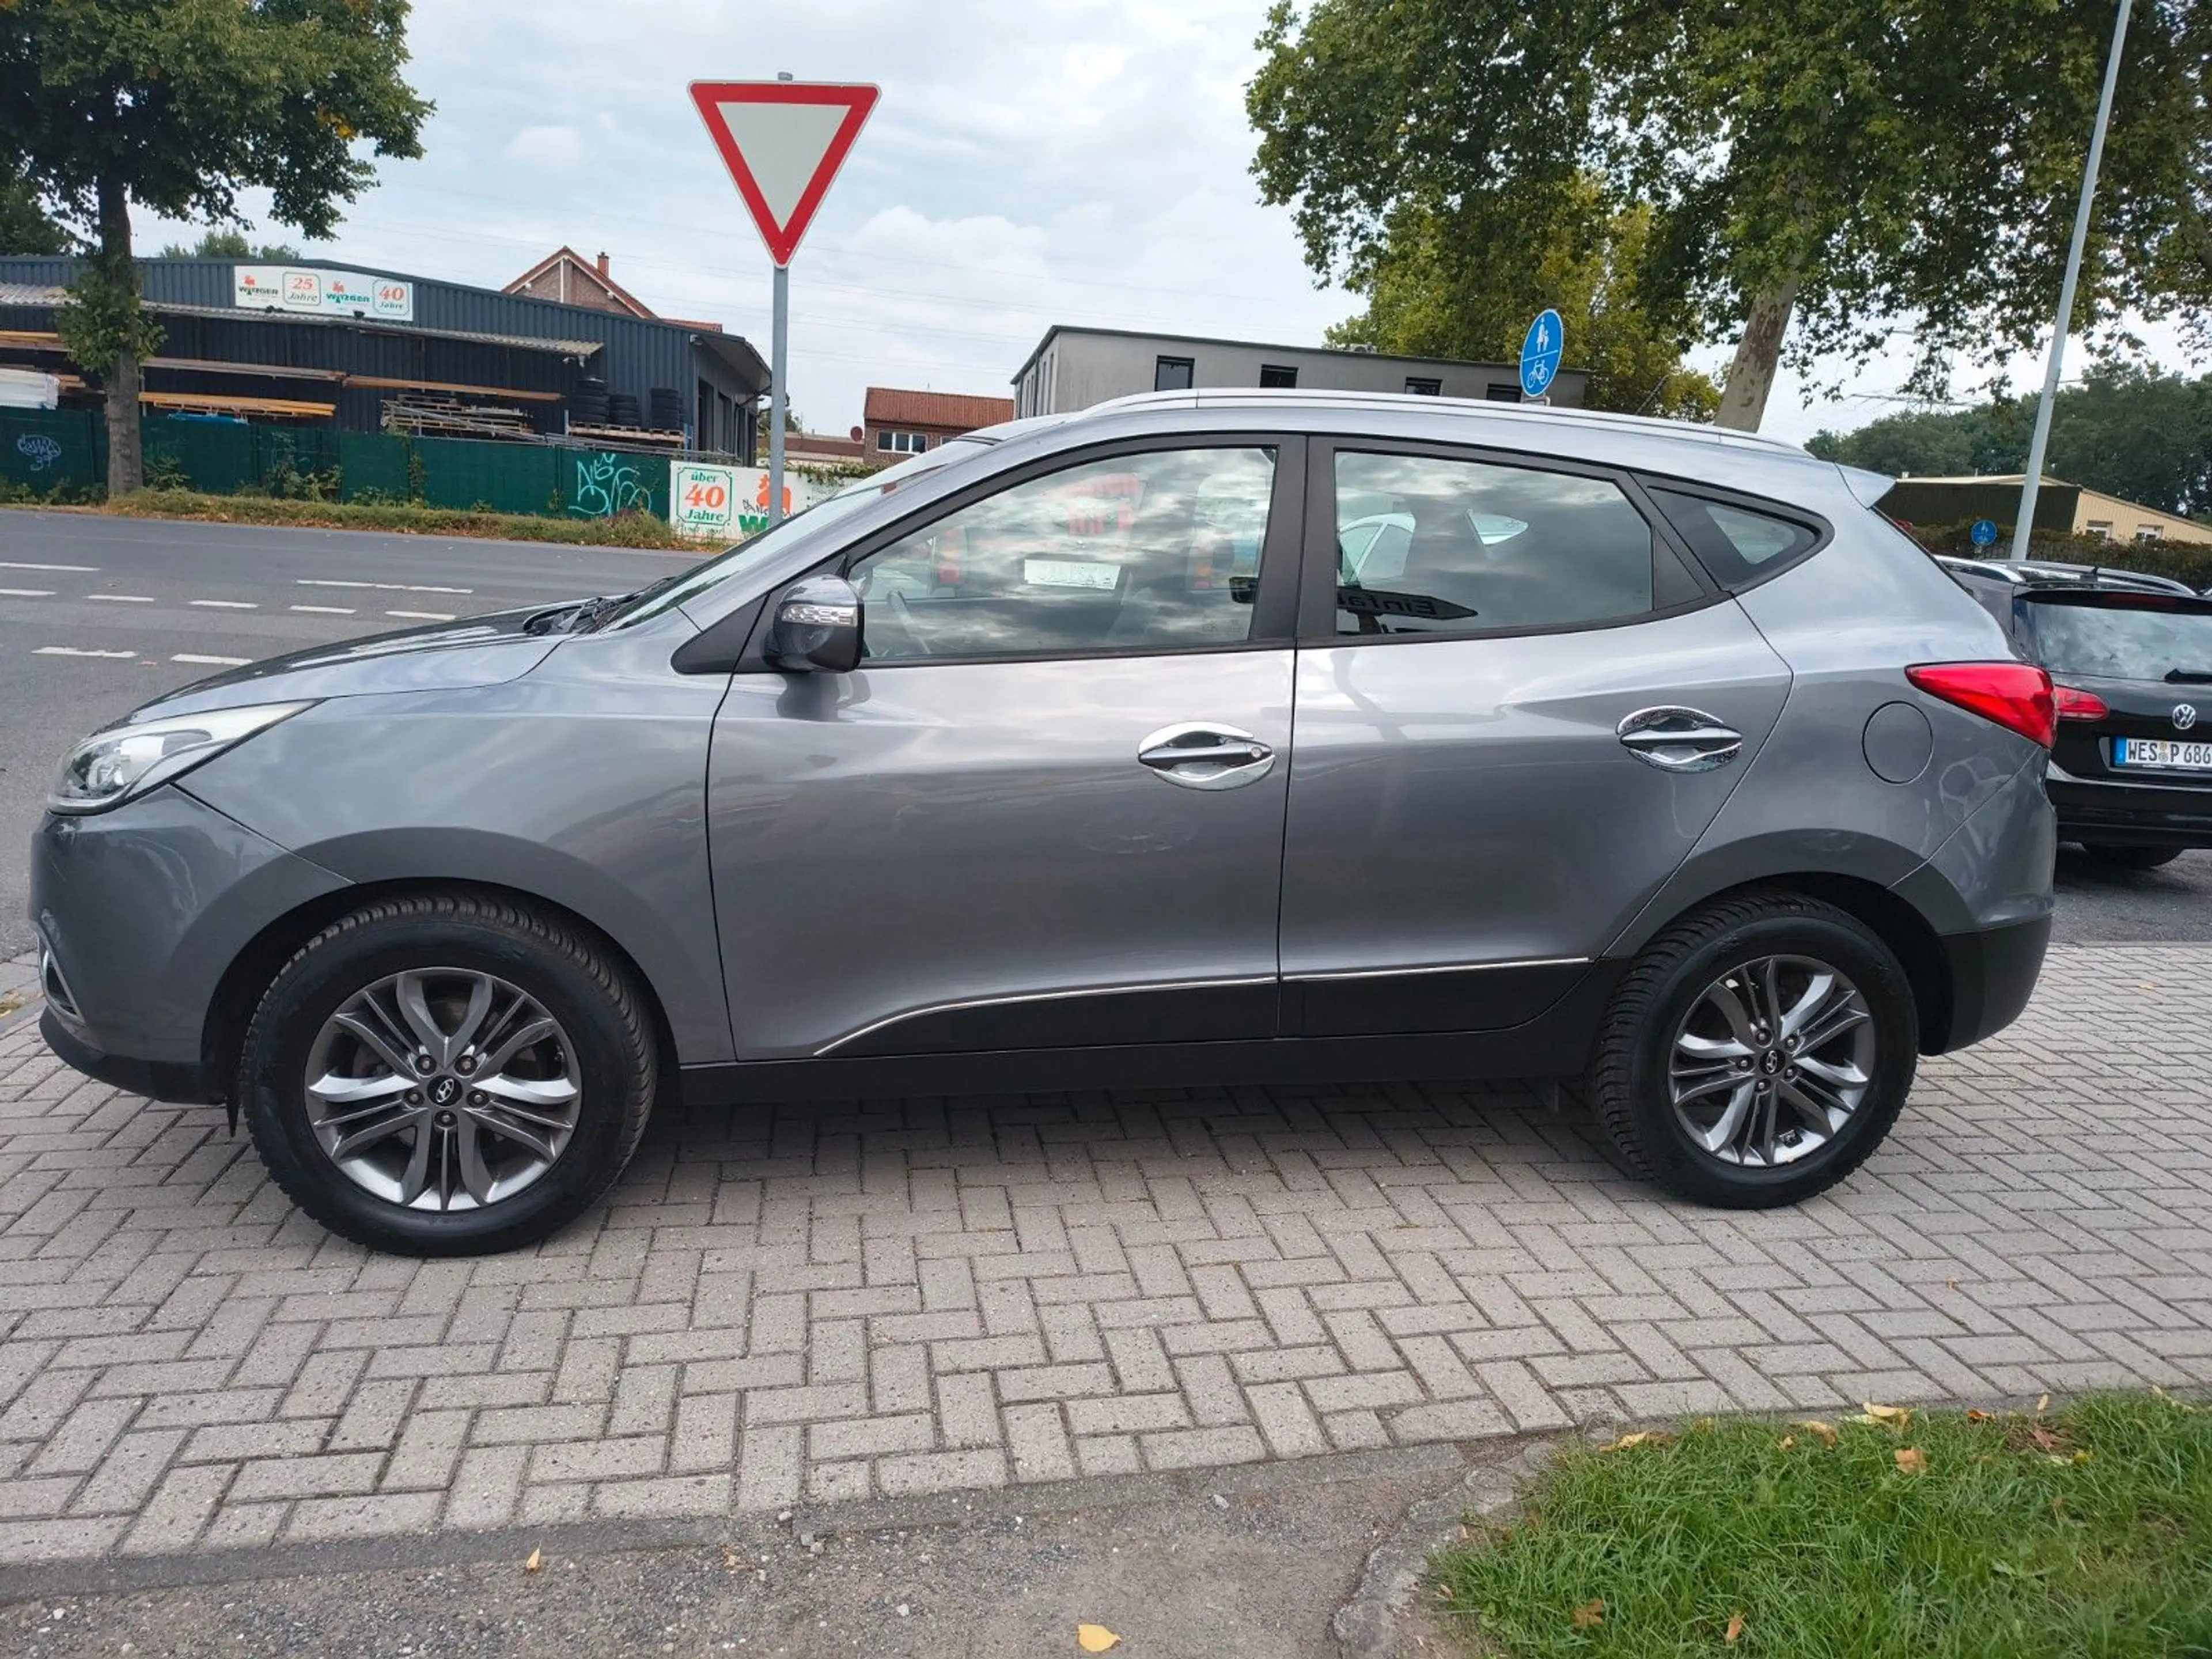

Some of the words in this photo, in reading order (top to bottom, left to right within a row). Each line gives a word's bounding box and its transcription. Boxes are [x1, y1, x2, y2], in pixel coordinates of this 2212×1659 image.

[292, 277, 313, 290] 25
[288, 291, 317, 301] Jahre
[378, 285, 404, 301] 40
[378, 301, 403, 309] Jahre
[691, 470, 717, 483] über
[684, 483, 725, 508] 40
[685, 509, 725, 521] Jahre
[2128, 741, 2158, 762] WES
[2169, 744, 2180, 763] P
[2183, 744, 2211, 764] 686
